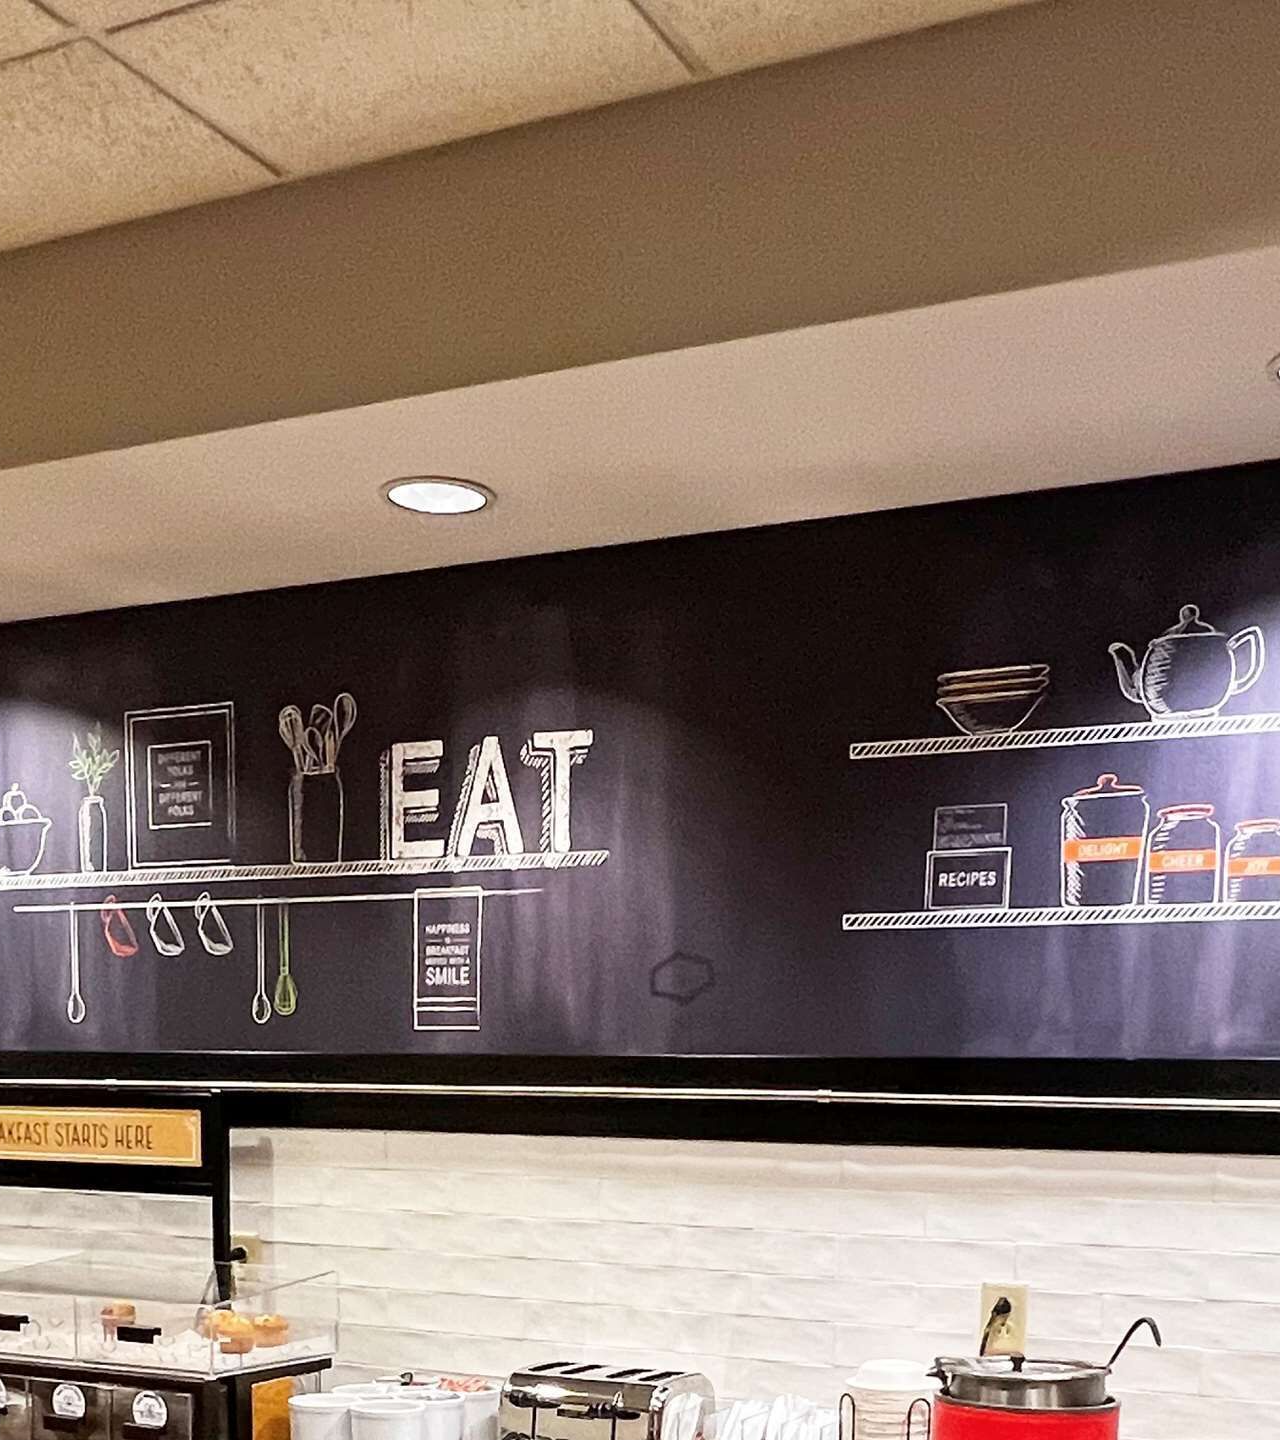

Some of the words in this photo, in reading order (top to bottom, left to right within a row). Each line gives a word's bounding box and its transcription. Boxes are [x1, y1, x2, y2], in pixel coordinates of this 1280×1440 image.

[381, 729, 594, 860] EAT
[1078, 842, 1129, 858] DELIGHT
[1161, 853, 1204, 868] CHEER
[938, 871, 997, 887] RECIPES
[425, 923, 470, 934] HAPPINESS
[425, 945, 470, 956] BREAKFAST
[425, 966, 470, 986] SMILE
[54, 1123, 109, 1149] STARTS
[114, 1125, 154, 1150] HERE
